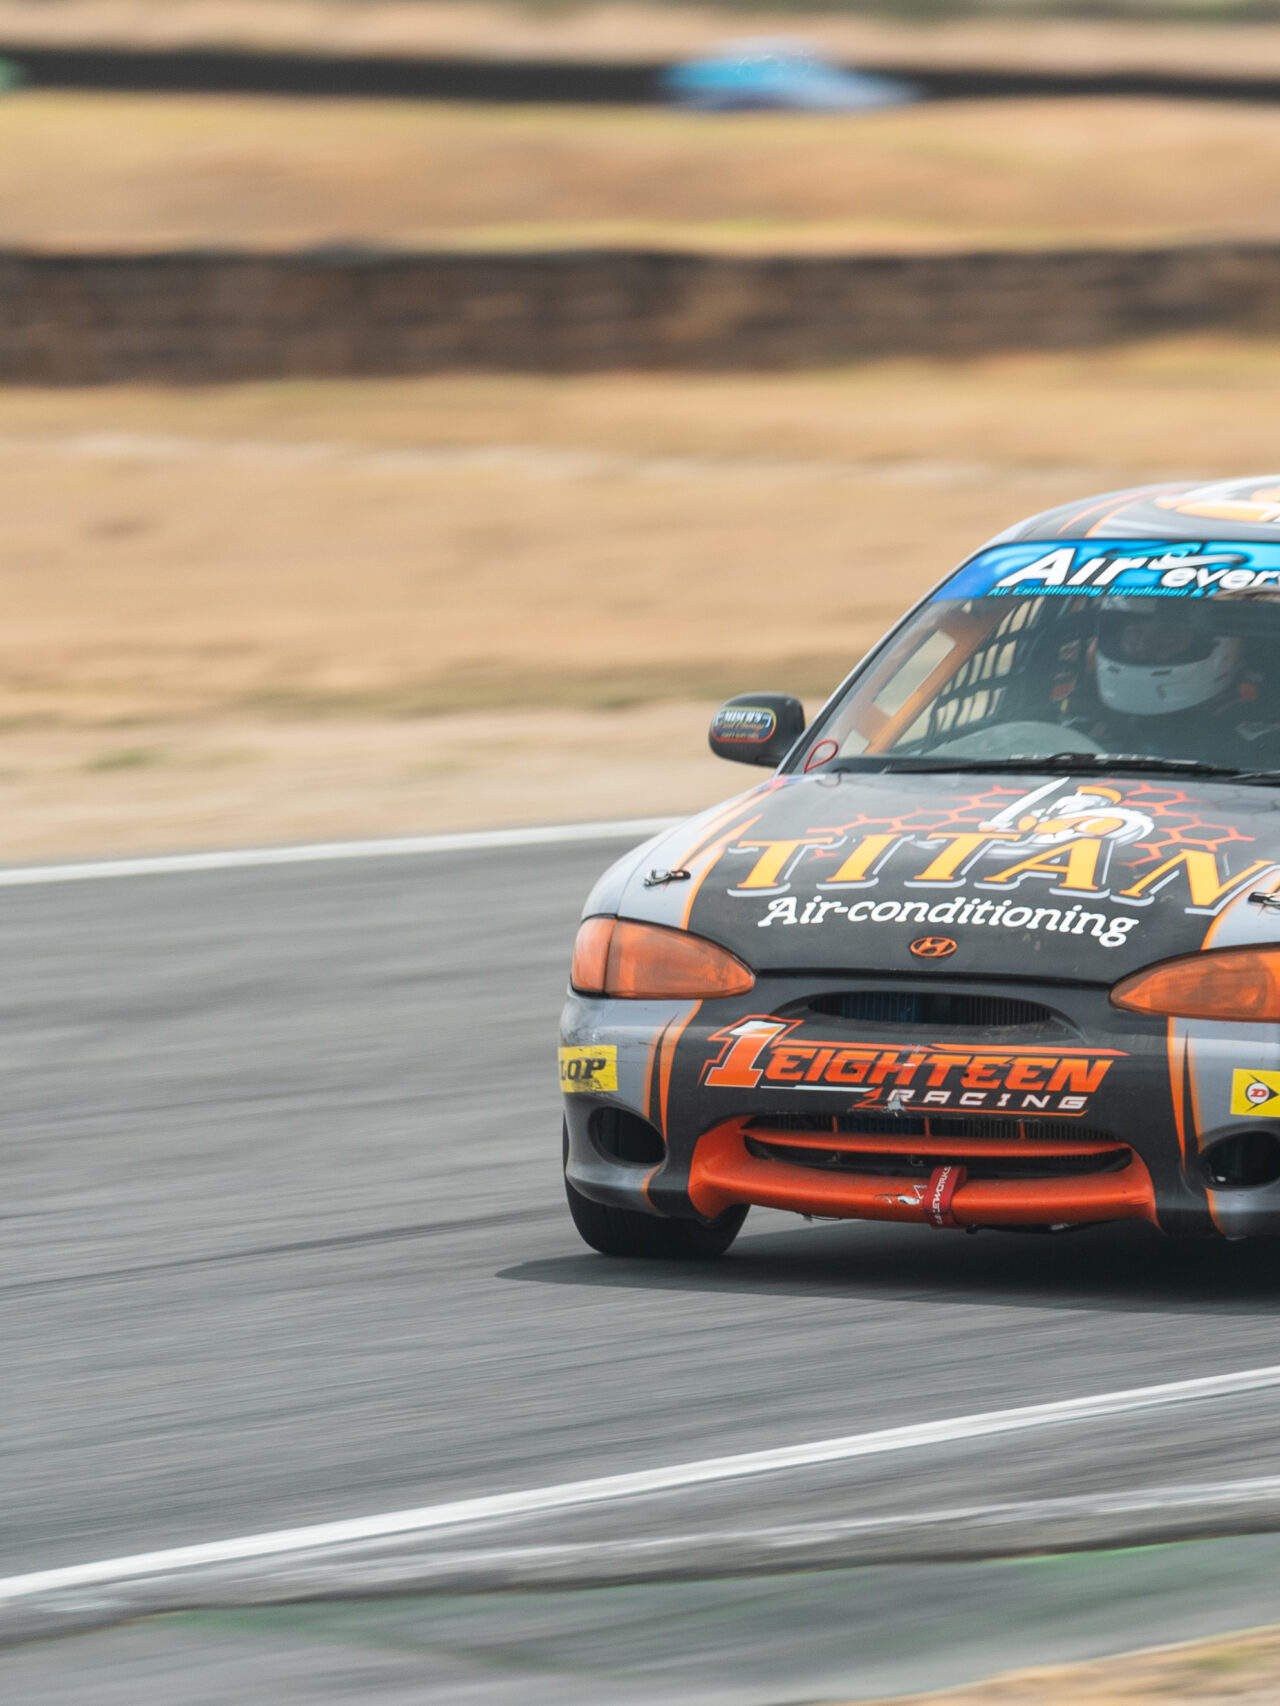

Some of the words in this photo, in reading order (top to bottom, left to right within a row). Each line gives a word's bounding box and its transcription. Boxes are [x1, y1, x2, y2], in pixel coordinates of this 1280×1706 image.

[995, 547, 1131, 586] Air
[757, 896, 1139, 948] Air-conditioning
[886, 1088, 1089, 1111] RACING
